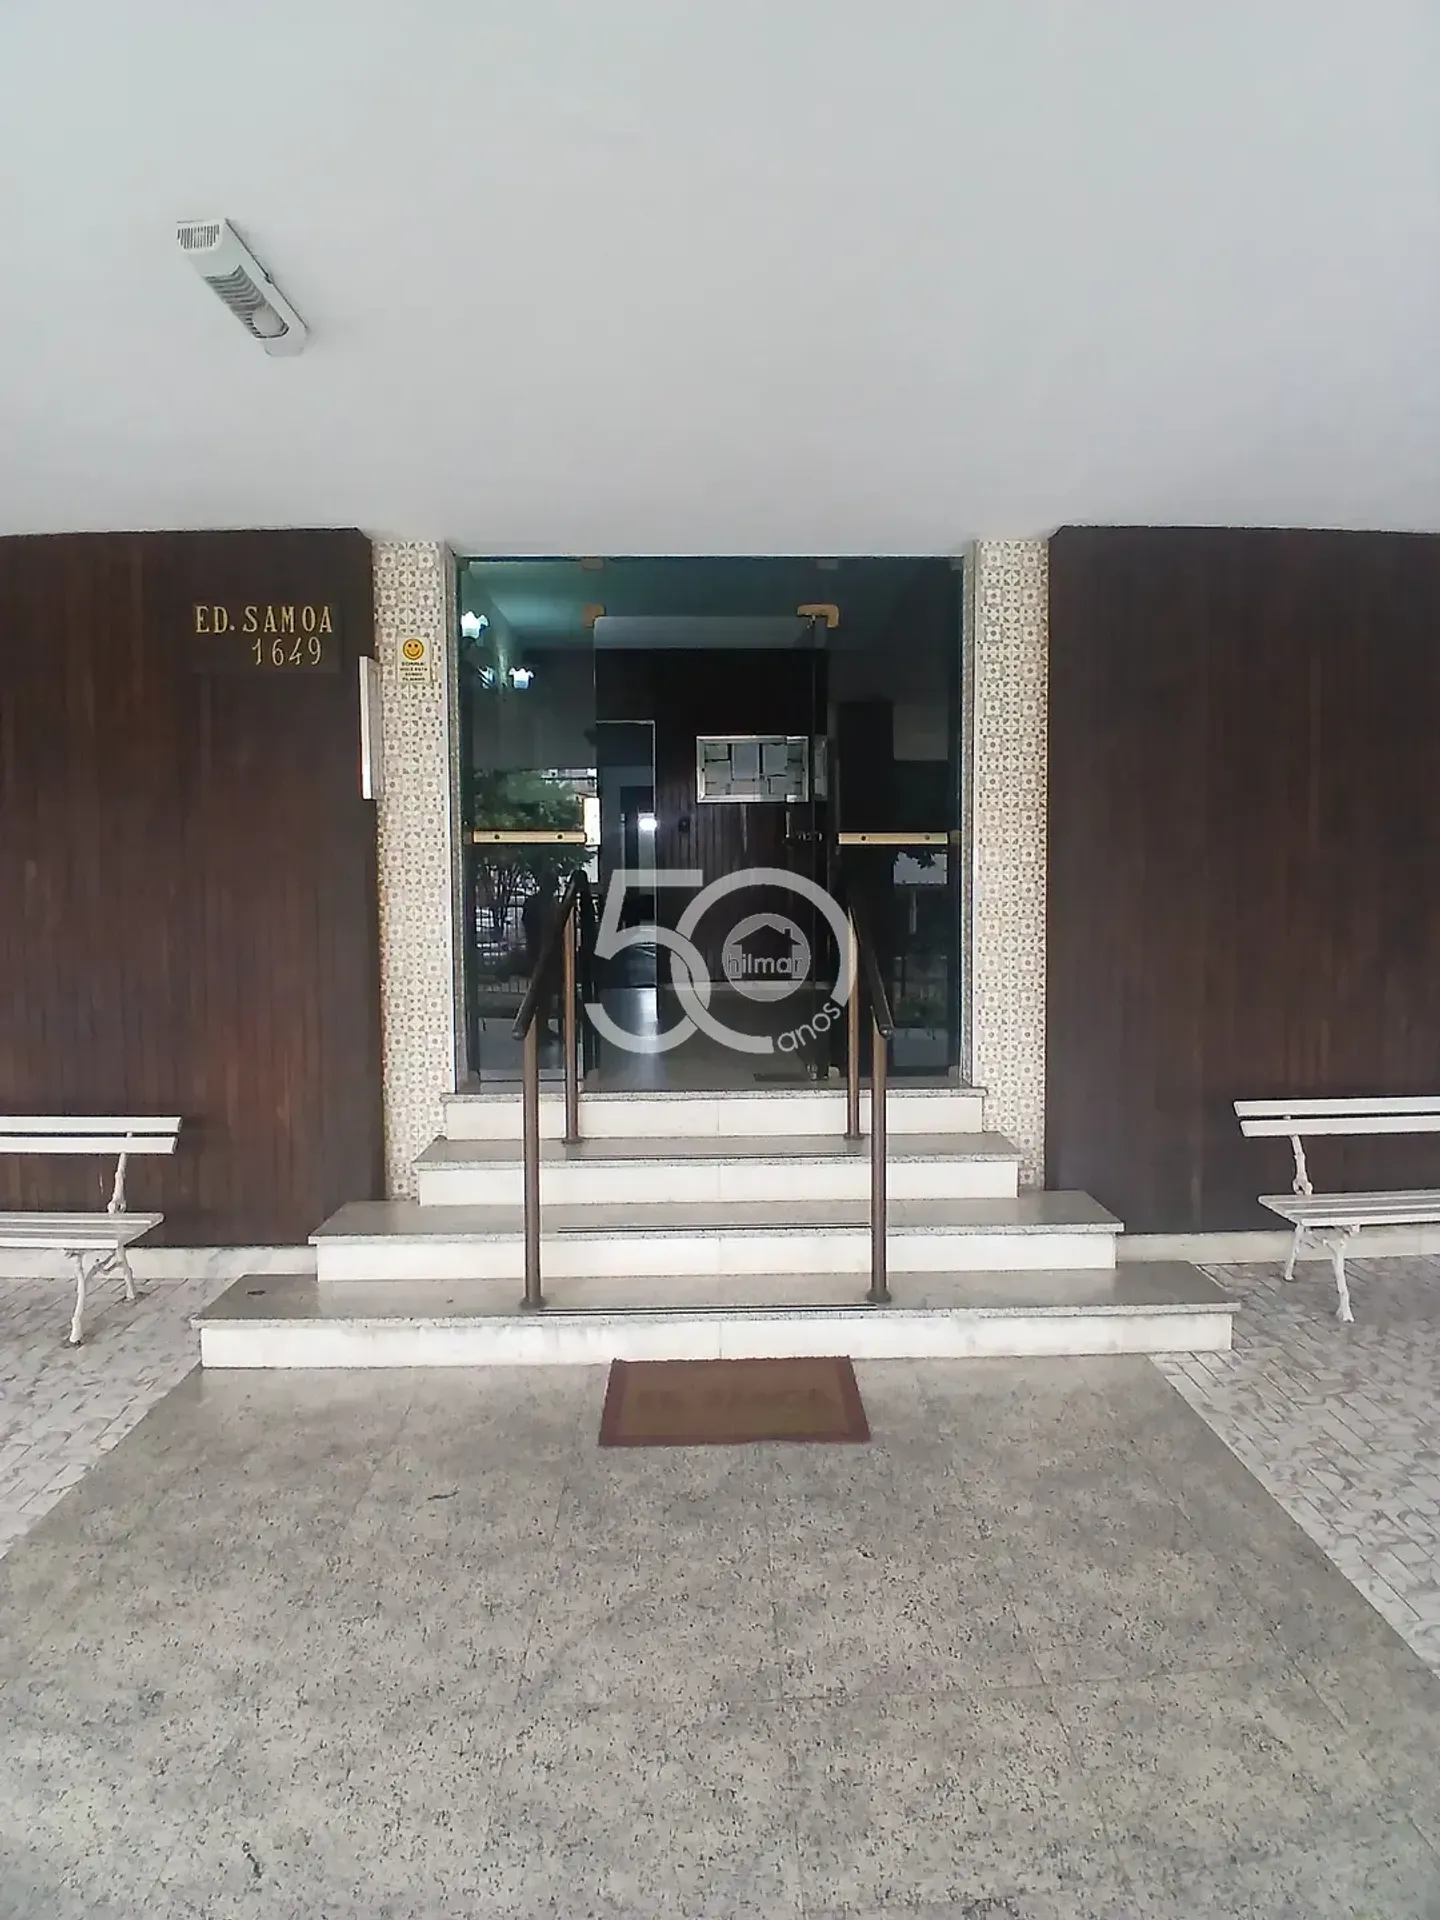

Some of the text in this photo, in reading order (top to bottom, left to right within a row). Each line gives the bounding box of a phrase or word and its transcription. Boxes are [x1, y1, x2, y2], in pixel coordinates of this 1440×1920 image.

[195, 605, 332, 633] ED. SAMOA
[252, 636, 322, 667] 1649
